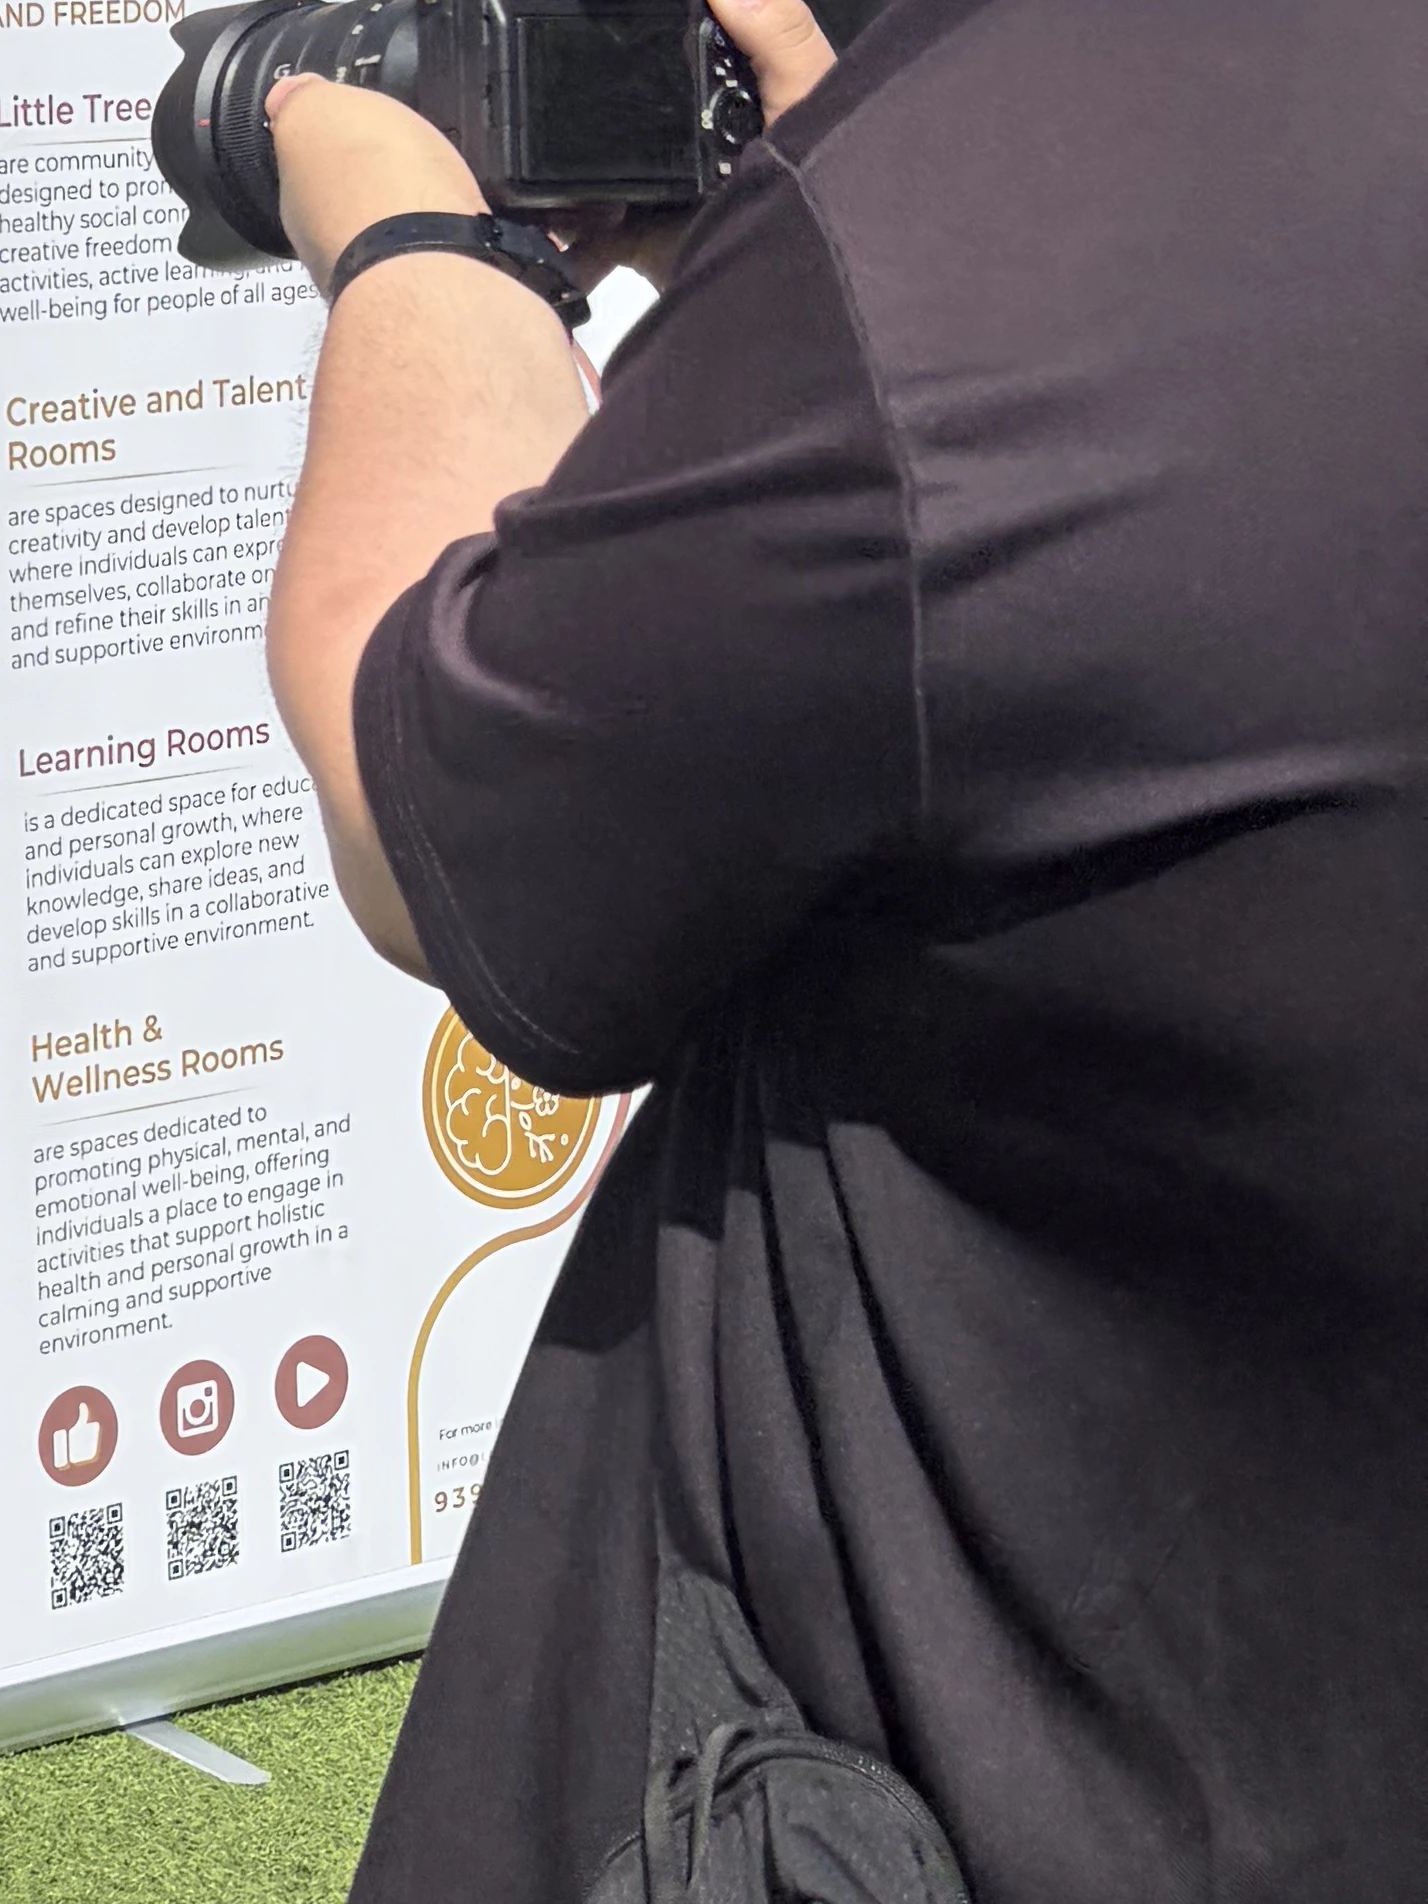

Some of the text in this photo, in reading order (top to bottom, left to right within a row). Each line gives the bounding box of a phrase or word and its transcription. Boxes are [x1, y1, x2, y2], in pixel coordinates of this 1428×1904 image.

[82, 94, 152, 125] Tree
[35, 149, 154, 174] community
[99, 180, 119, 198] to
[0, 210, 75, 235] healthy
[80, 205, 136, 228] social
[85, 233, 172, 258] freedom
[0, 268, 92, 293] activities,
[99, 264, 159, 286] active
[0, 296, 107, 322] well-being
[114, 293, 141, 314] for
[148, 287, 215, 316] people
[221, 284, 239, 305] of
[244, 282, 264, 303] all
[6, 374, 307, 426] Creative and Talent
[9, 439, 116, 470] Rooms
[8, 485, 238, 526] are spaces designed to
[9, 530, 102, 555] creativity
[108, 520, 145, 544] and
[152, 514, 230, 539] develop
[9, 545, 227, 583] where individuals can
[10, 570, 245, 612] themselves, collaborate
[11, 598, 218, 641] and refine their skills
[12, 624, 262, 669] and supportive environm
[20, 723, 270, 777] Learning Rooms
[61, 794, 162, 826] dedicated
[169, 790, 225, 815] space
[231, 782, 256, 803] for
[25, 806, 303, 860] and personal growth, where
[26, 834, 299, 889] individuals can explore new
[27, 856, 306, 916] knowledge, share ideas, and
[27, 882, 329, 944] develop skills collaborative
[28, 911, 314, 972] and supportive environment.
[32, 1015, 162, 1062] Health &
[32, 1040, 284, 1103] Wellness Rooms
[34, 1106, 267, 1163] are spaces dedicated to
[35, 1113, 350, 1196] promoting physical, mental, and
[35, 1149, 329, 1218] emotional well-being, offering
[37, 1177, 320, 1246] individuals place to engage
[37, 1203, 325, 1273] activities that support holistic
[38, 1229, 309, 1301] health and personal growth
[39, 1267, 272, 1328] calming and supportive
[40, 1313, 173, 1355] environment.
